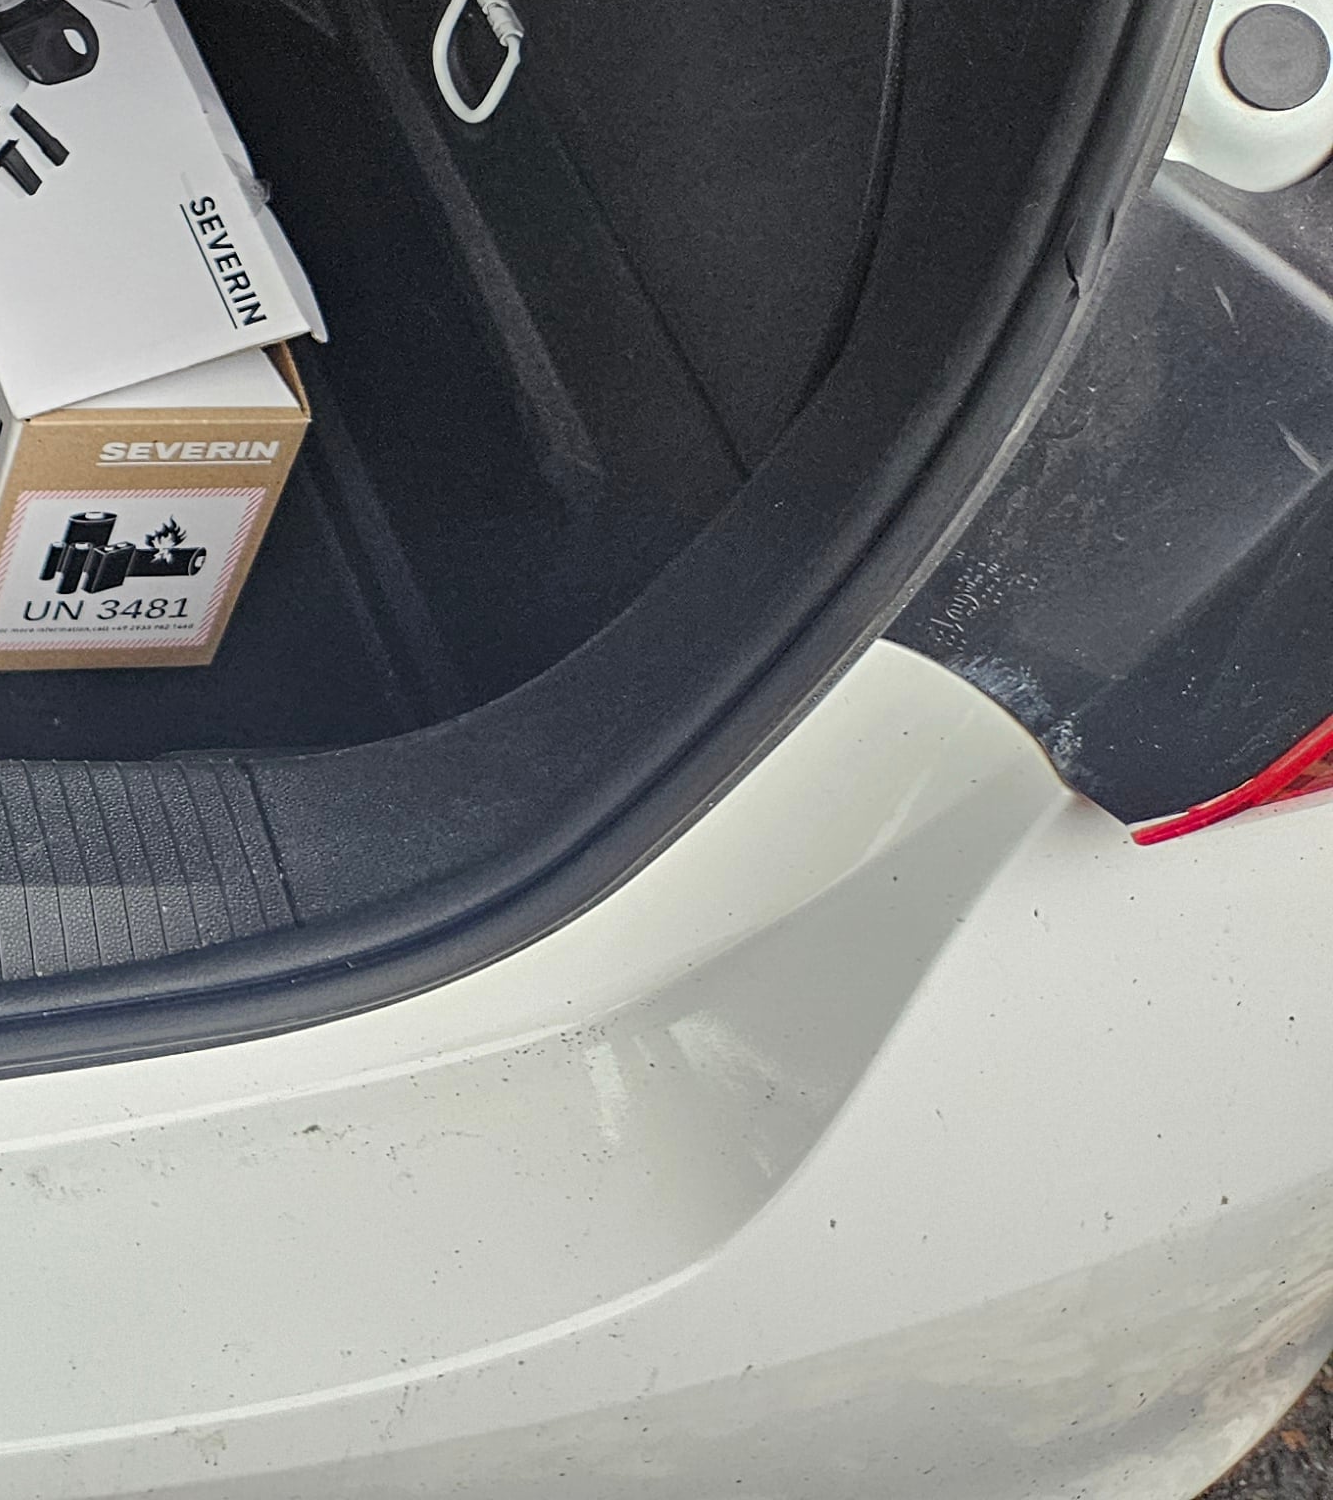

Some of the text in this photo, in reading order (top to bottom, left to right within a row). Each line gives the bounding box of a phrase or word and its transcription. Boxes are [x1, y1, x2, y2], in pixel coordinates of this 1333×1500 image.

[189, 194, 268, 328] SEVERIN
[98, 440, 280, 462] SEVERIN
[22, 597, 190, 622] UN 3481
